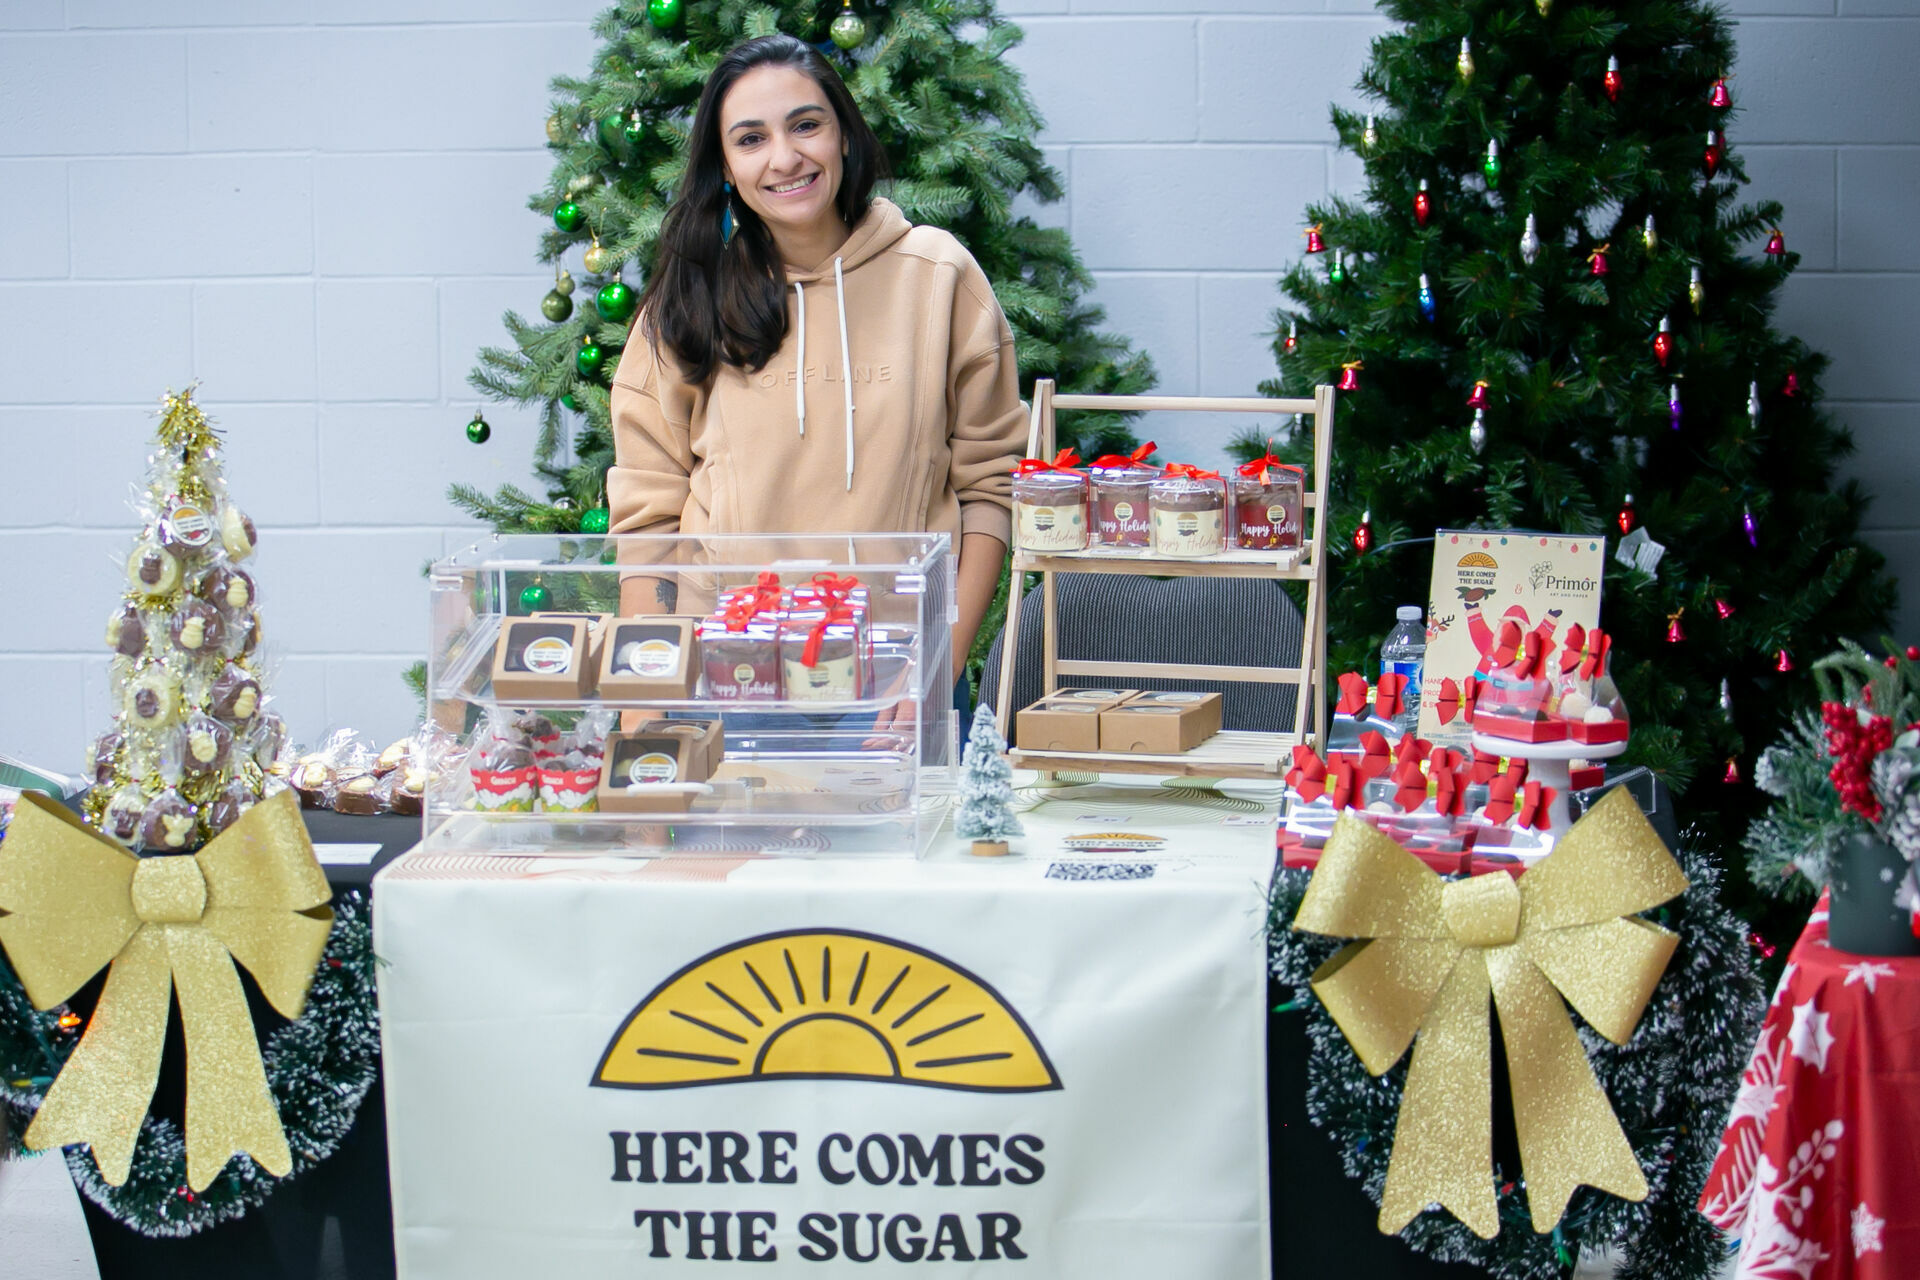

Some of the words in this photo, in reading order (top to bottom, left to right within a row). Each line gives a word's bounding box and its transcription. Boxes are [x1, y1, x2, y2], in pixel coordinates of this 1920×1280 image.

[1240, 522, 1270, 537] Happy
[1273, 521, 1298, 535] Holid
[1459, 577, 1473, 585] THE
[608, 1130, 798, 1185] HERE
[817, 1132, 1046, 1187] COMES
[633, 1209, 778, 1263] THE
[797, 1211, 1029, 1264] SUGAR
